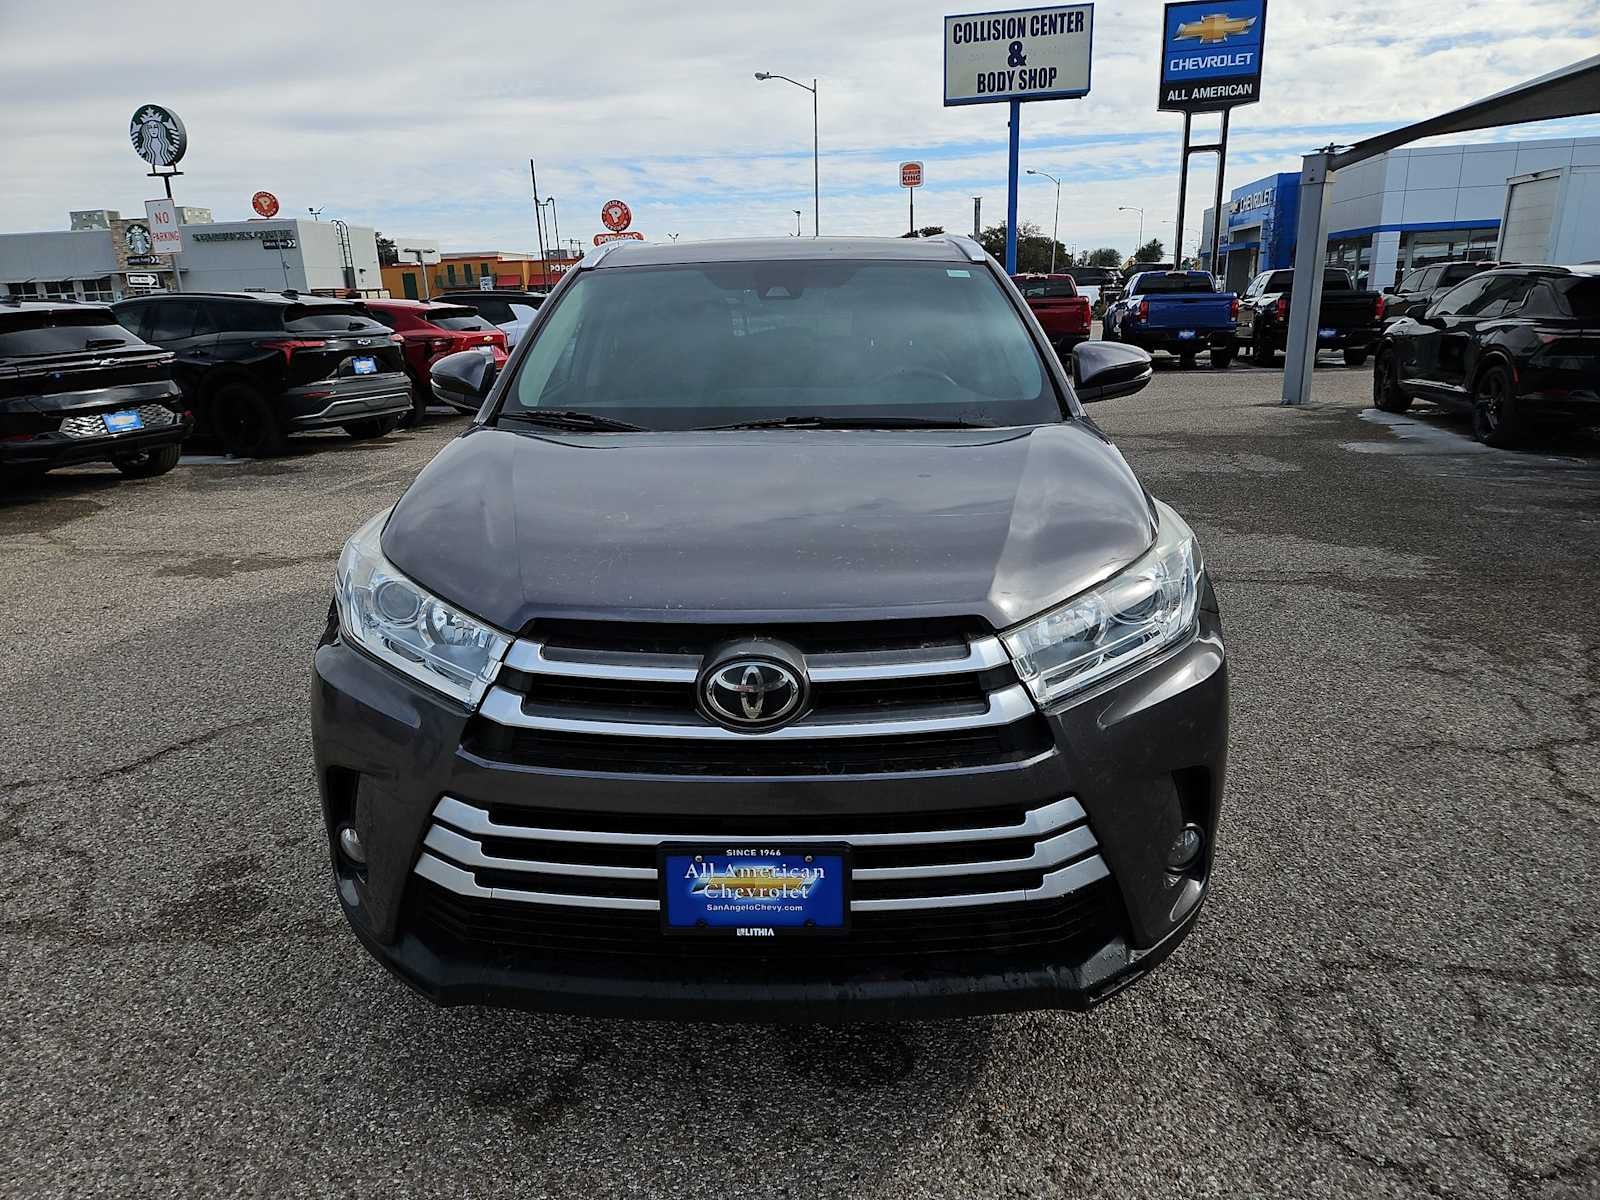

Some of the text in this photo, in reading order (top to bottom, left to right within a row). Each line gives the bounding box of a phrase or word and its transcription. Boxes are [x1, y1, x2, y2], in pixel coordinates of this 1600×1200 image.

[953, 11, 1084, 44] COLLISION CENTER
[1007, 40, 1027, 67] &
[1169, 52, 1254, 71] CHEVROLET
[977, 67, 1057, 94] BODY SHOP
[1167, 83, 1252, 101] ALL AMERICAN
[1240, 187, 1274, 212] CHEVROLET
[154, 212, 169, 224] NO
[152, 231, 179, 241] PARKING
[726, 849, 782, 857] SINCE 1946
[684, 862, 825, 879] All American
[703, 883, 809, 899] Chevrolet
[706, 903, 803, 913] SanAngeloChevy.com
[745, 928, 775, 936] LITHIA
